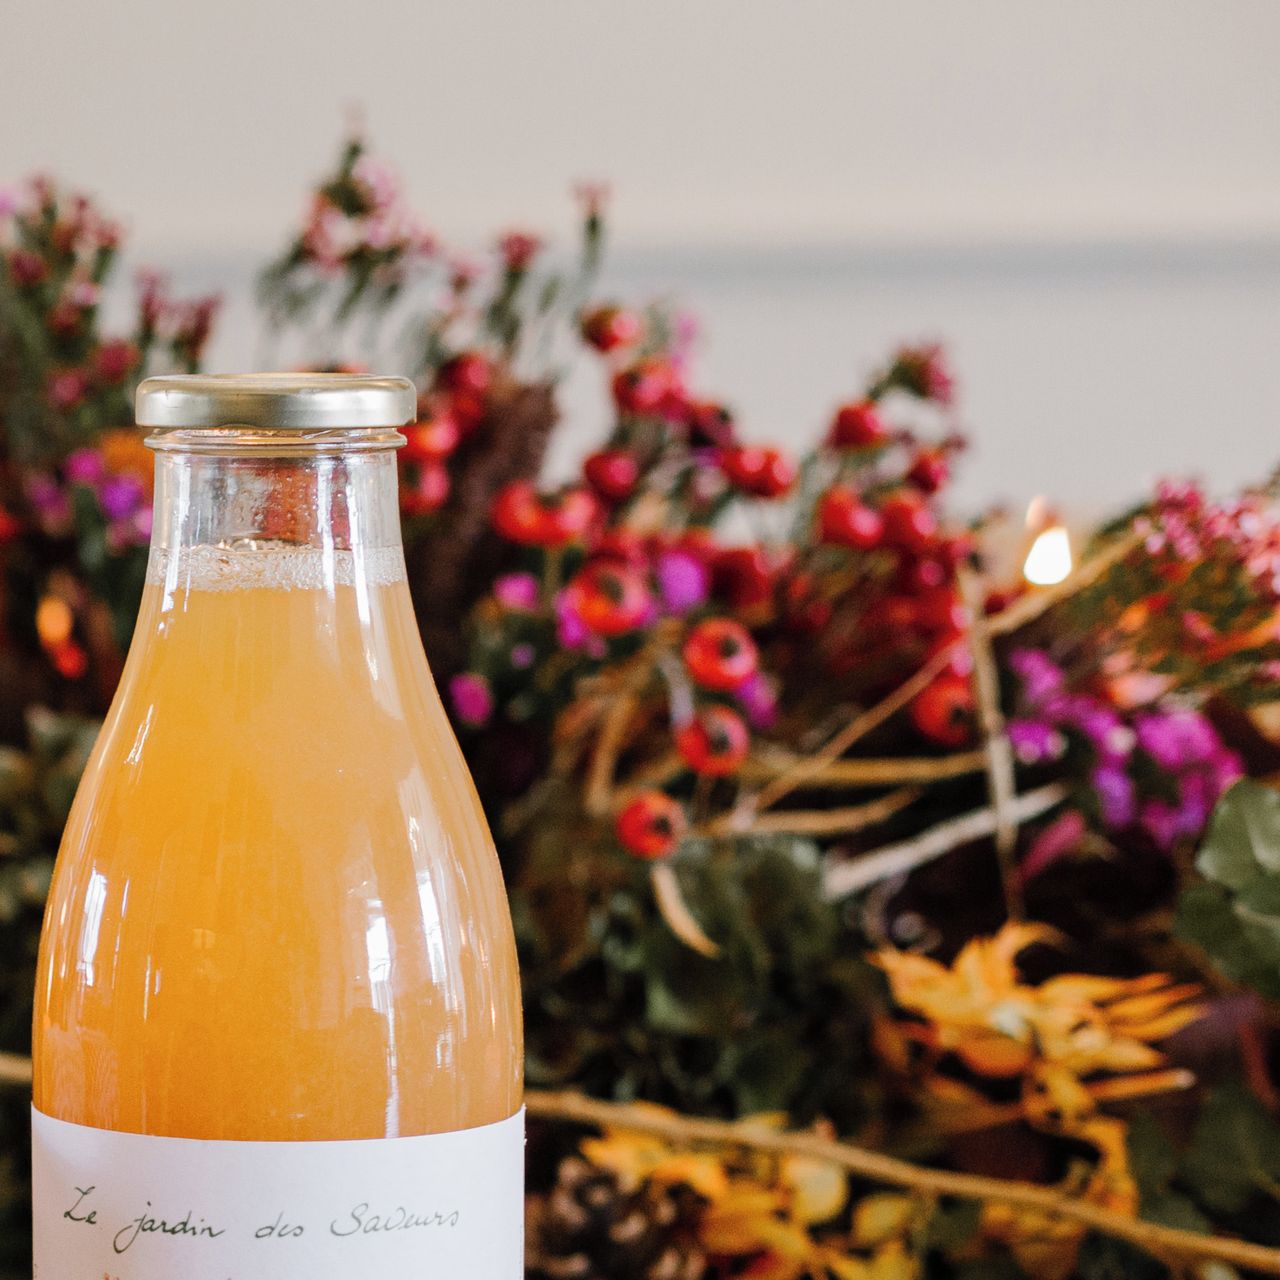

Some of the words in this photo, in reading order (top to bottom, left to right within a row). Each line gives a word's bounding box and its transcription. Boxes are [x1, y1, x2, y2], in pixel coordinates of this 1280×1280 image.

[63, 1186, 97, 1225] Le
[113, 1201, 226, 1254] jardin
[254, 1211, 304, 1239] des
[330, 1202, 459, 1237] Saveurs
